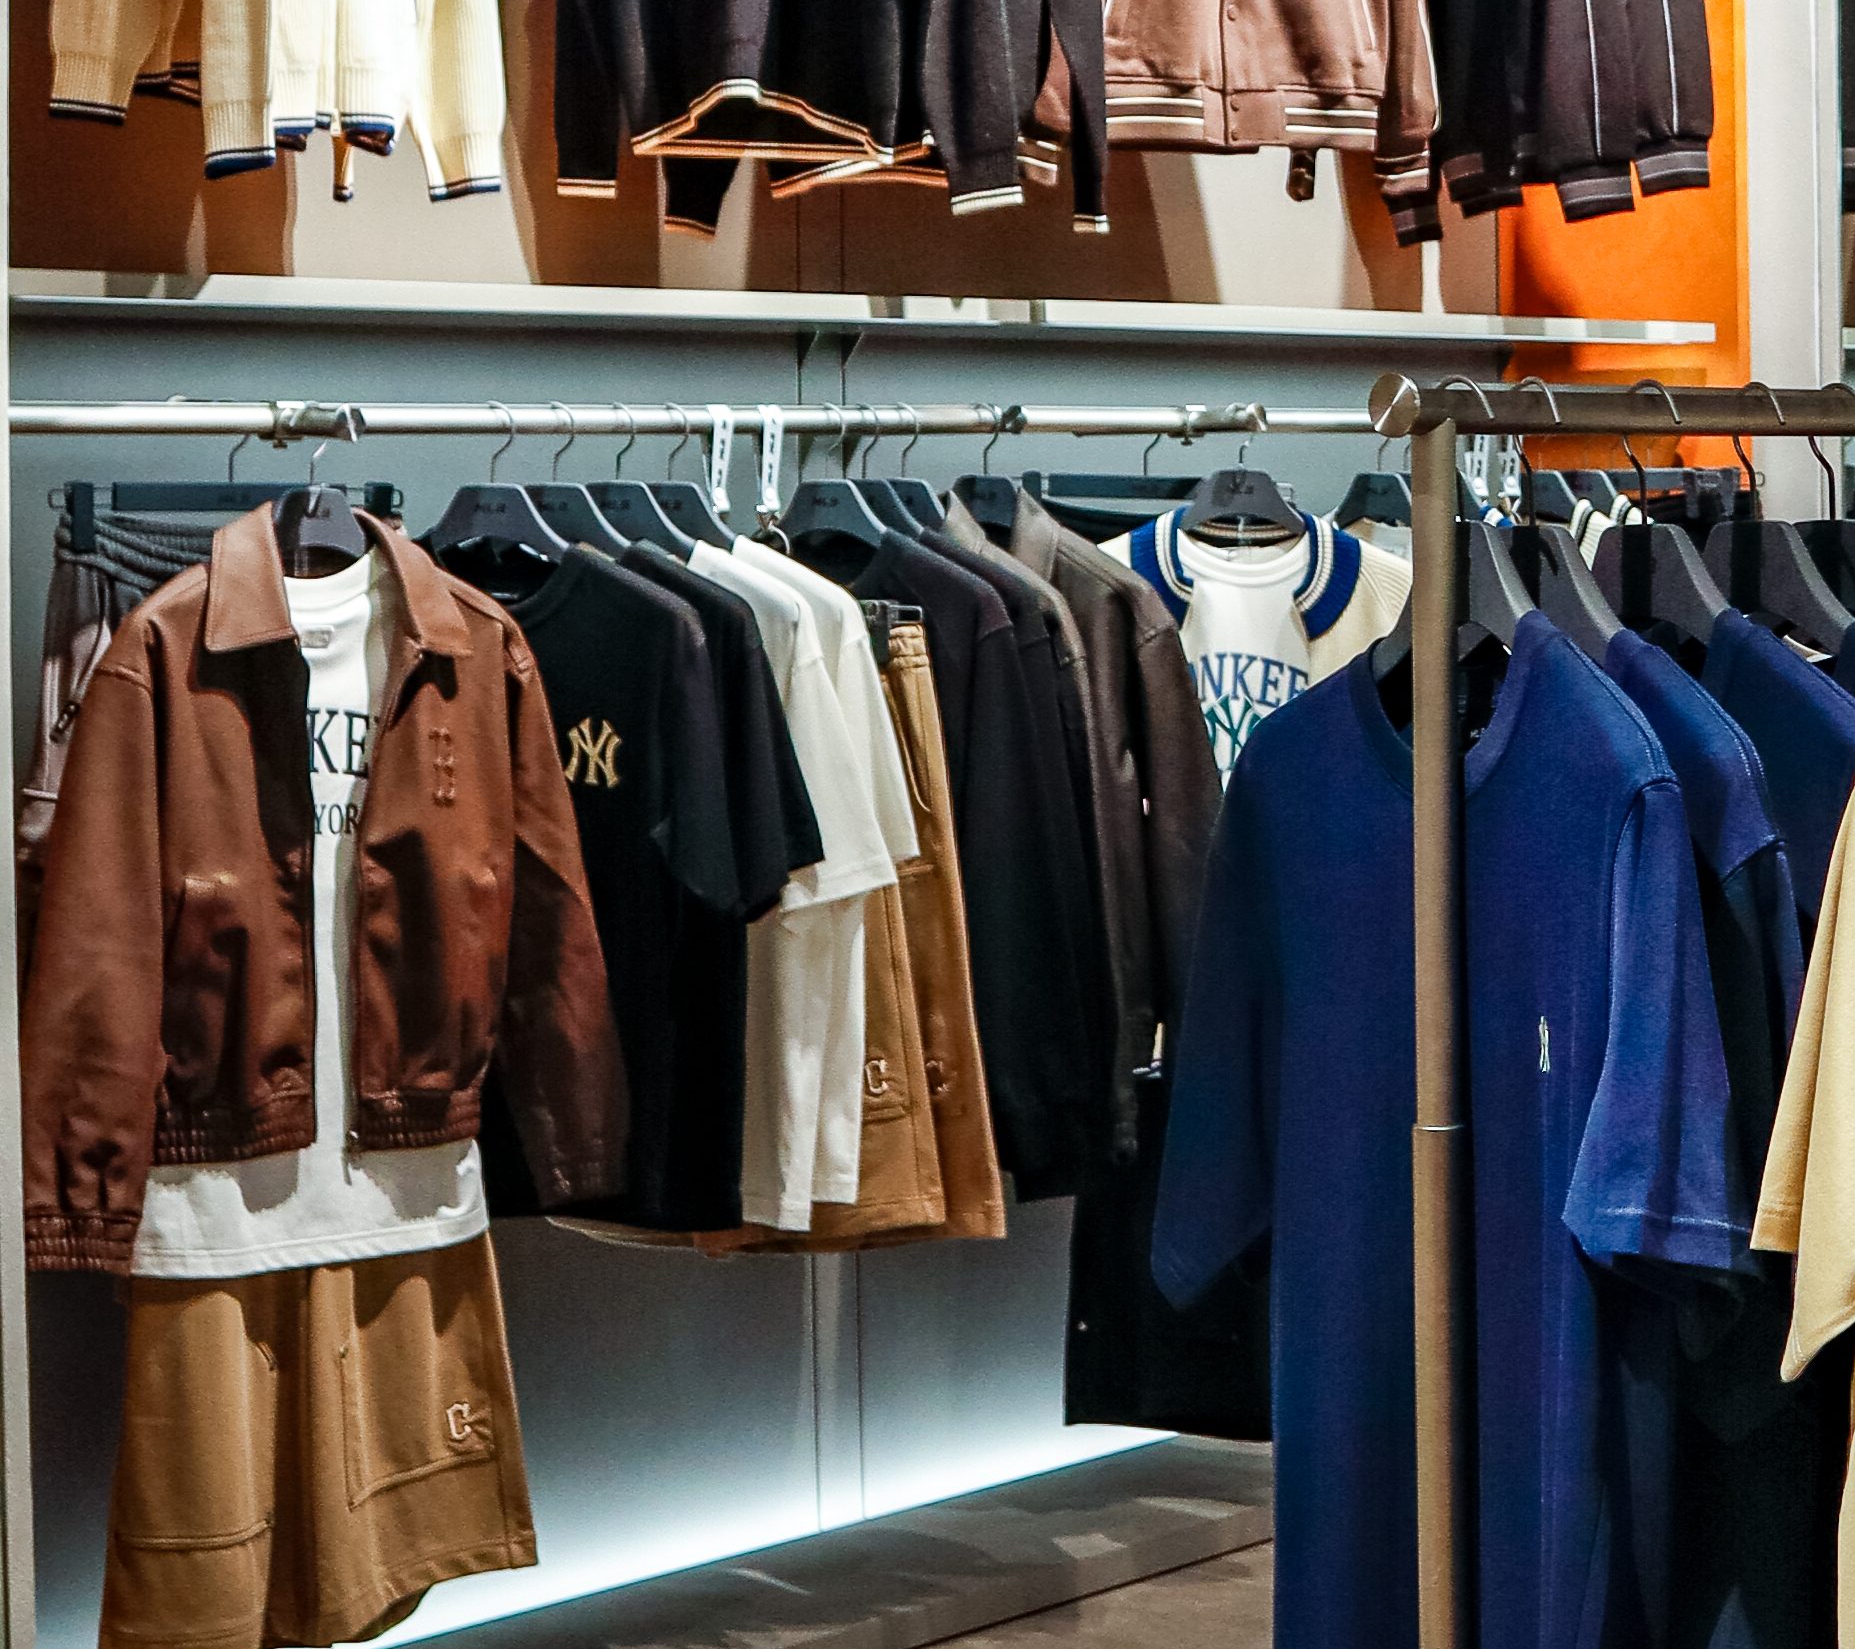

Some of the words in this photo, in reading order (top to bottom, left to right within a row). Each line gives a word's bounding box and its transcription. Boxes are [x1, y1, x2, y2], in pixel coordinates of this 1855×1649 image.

[1187, 654, 1309, 707] NKEE
[564, 717, 622, 788] NY
[864, 1059, 889, 1095] C
